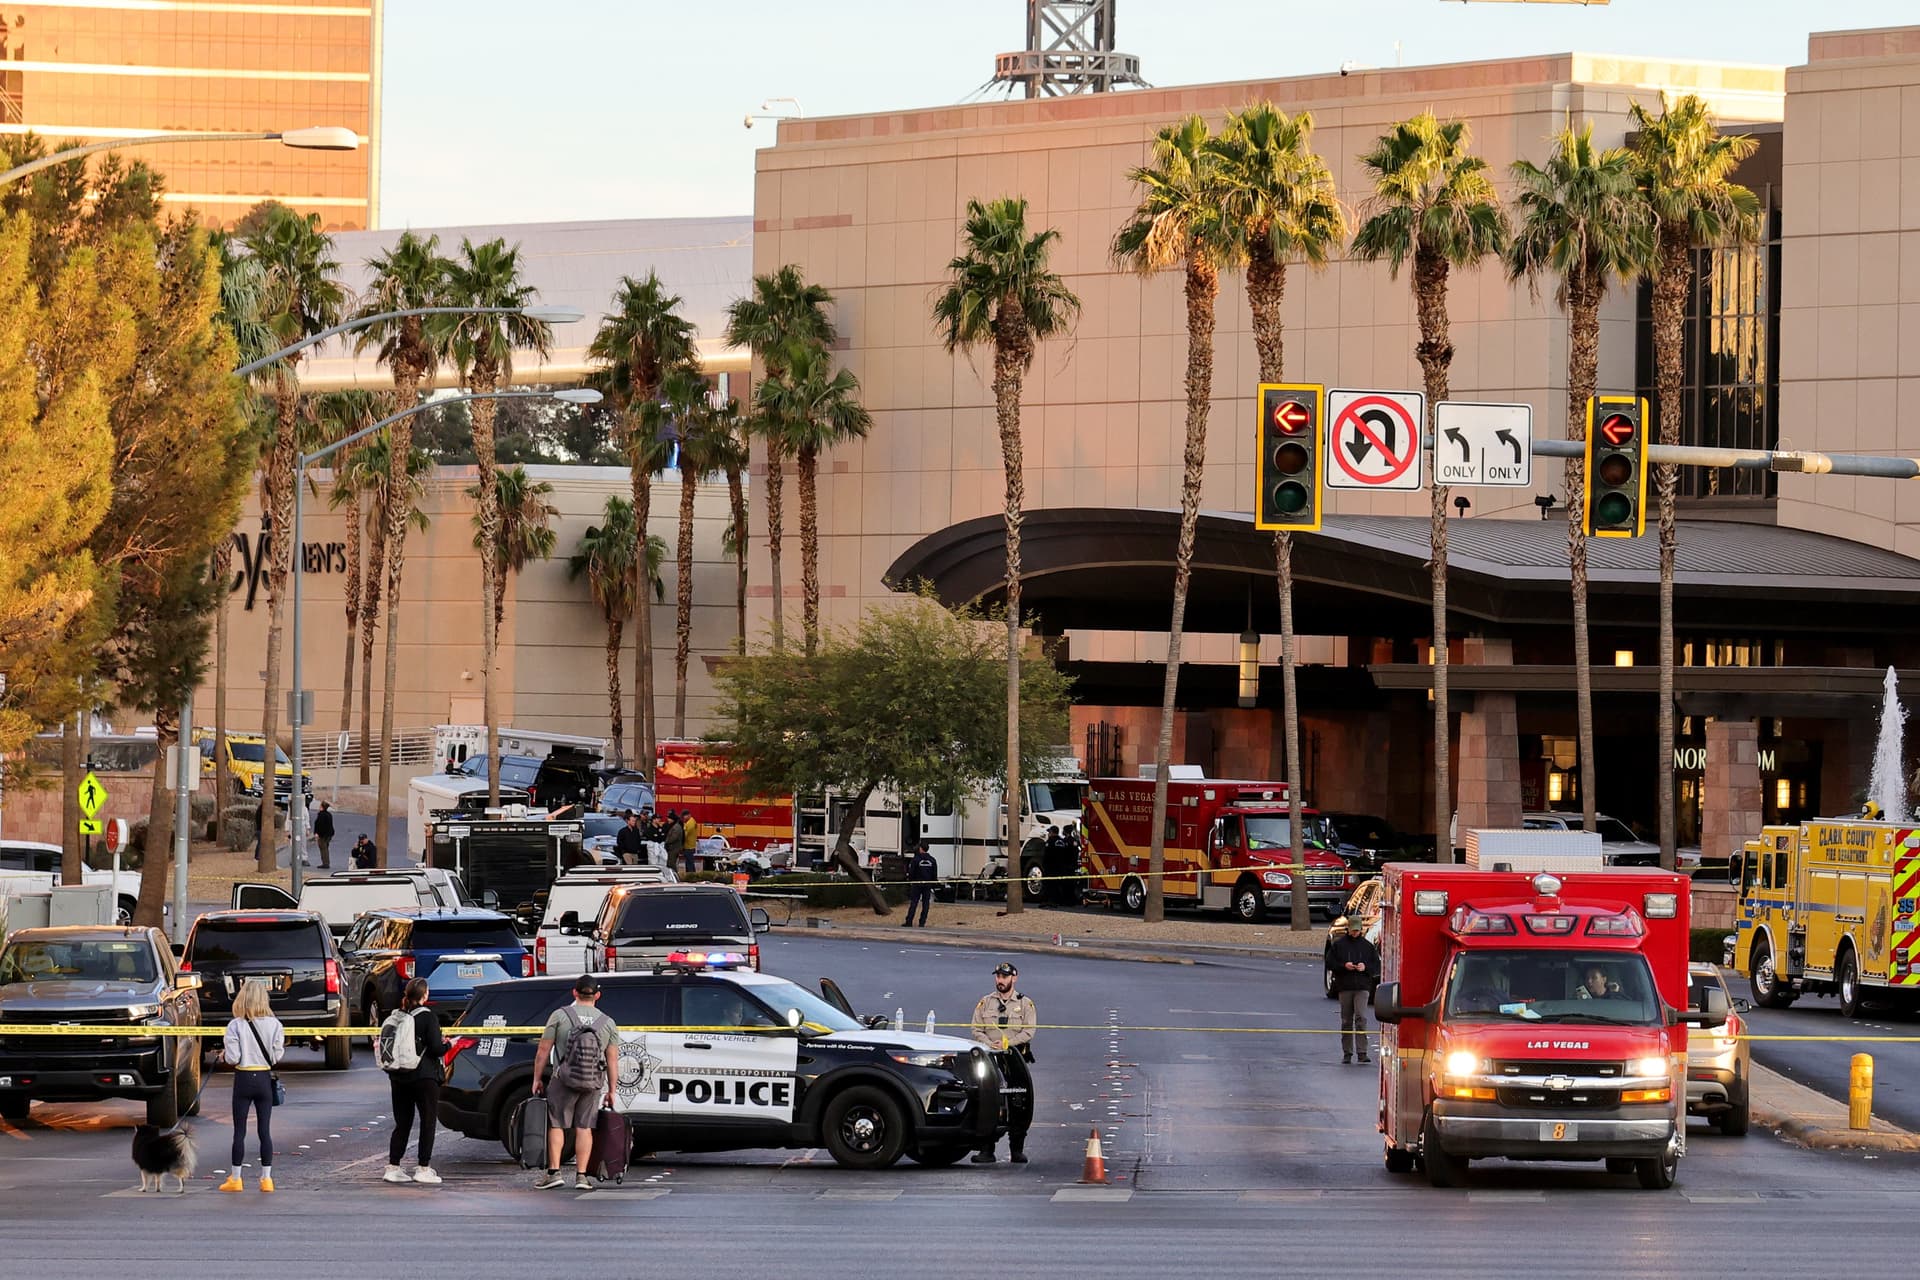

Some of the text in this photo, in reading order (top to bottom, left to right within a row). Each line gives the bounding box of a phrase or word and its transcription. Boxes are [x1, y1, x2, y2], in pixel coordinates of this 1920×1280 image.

[1443, 465, 1476, 478] ONLY
[1488, 466, 1522, 479] ONLY
[1109, 791, 1156, 802] LAS VEGAS
[1133, 805, 1153, 814] RESCU
[1819, 828, 1876, 849] CLARK COUNTY
[684, 1033, 757, 1043] TACTICAL VEHICLE
[1528, 1041, 1589, 1049] LAS VEGAS
[716, 1068, 788, 1077] METROPOLITAN
[659, 1078, 790, 1107] POLICE
[1552, 1122, 1566, 1140] 8
